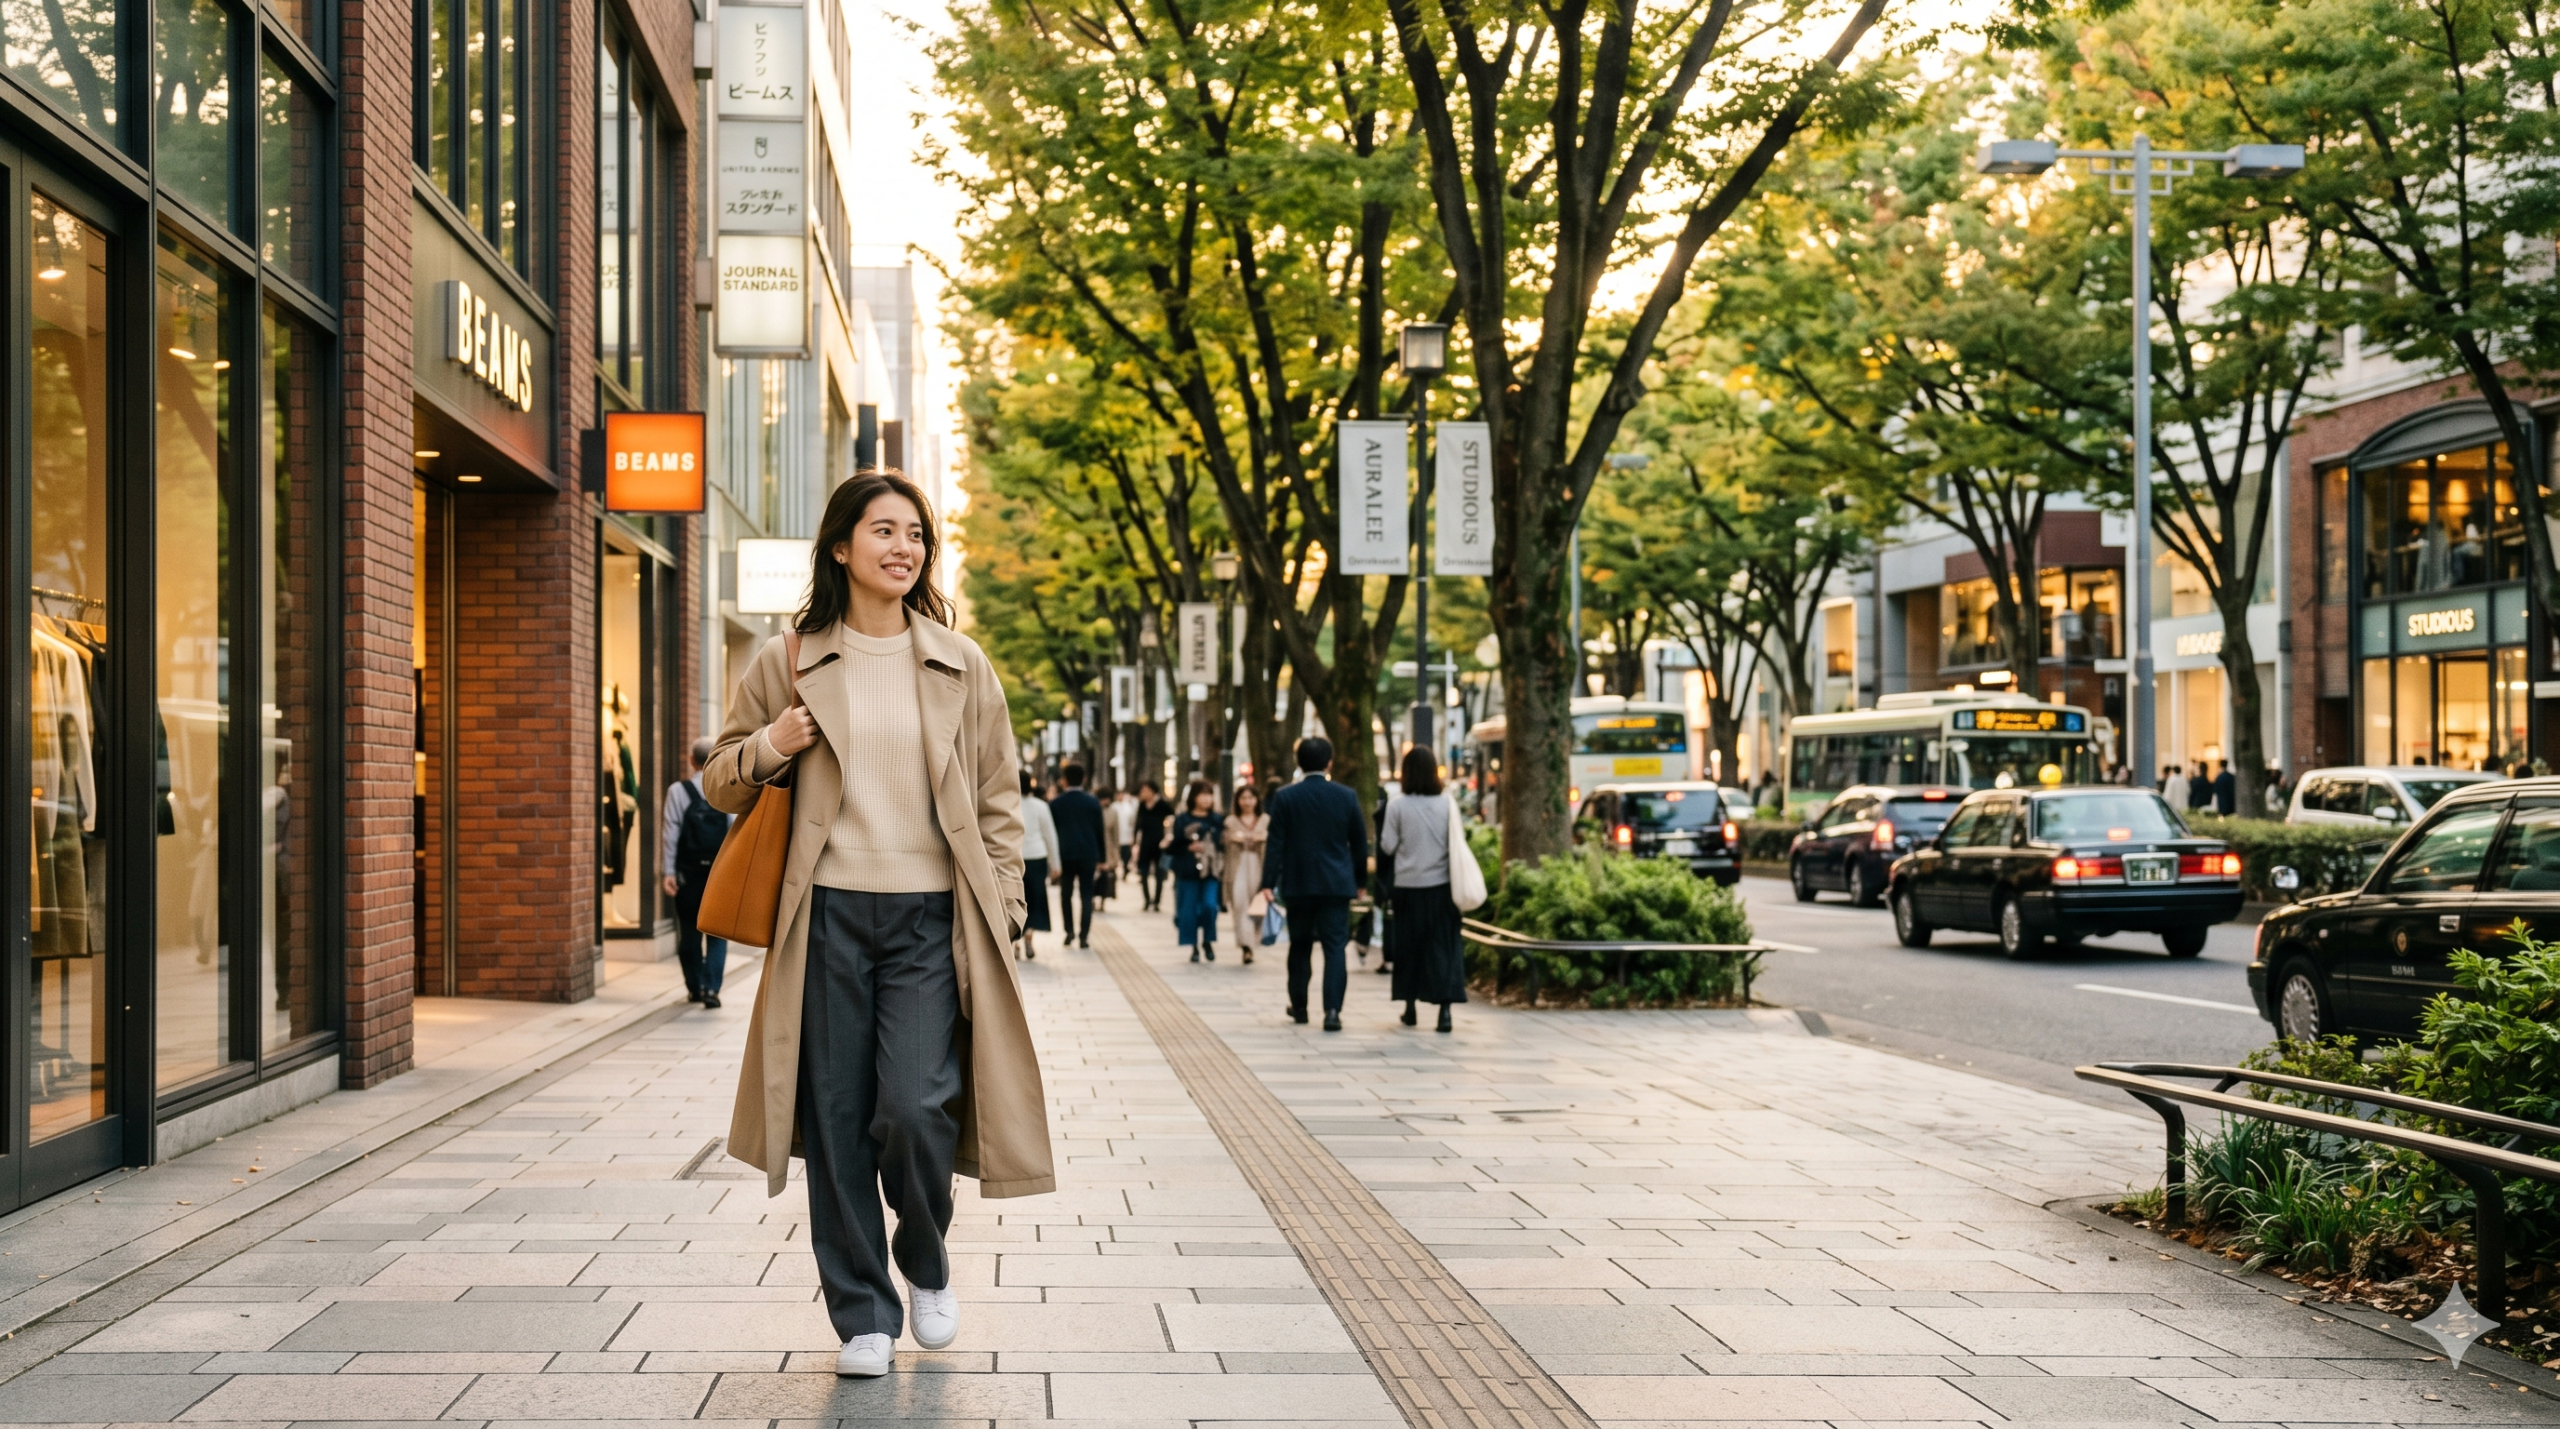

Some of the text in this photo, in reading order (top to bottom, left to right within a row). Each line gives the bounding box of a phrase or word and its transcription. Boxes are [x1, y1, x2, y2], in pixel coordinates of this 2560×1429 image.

[760, 166, 800, 174] ARROWS
[724, 266, 798, 278] JOURNAL
[724, 280, 799, 292] STANDARD
[457, 280, 532, 413] BEAMS
[614, 452, 695, 472] BEAMS
[1365, 438, 1383, 543] AURALEE
[1462, 440, 1479, 545] STUDIOUS
[2408, 607, 2475, 637] STUDIOUS
